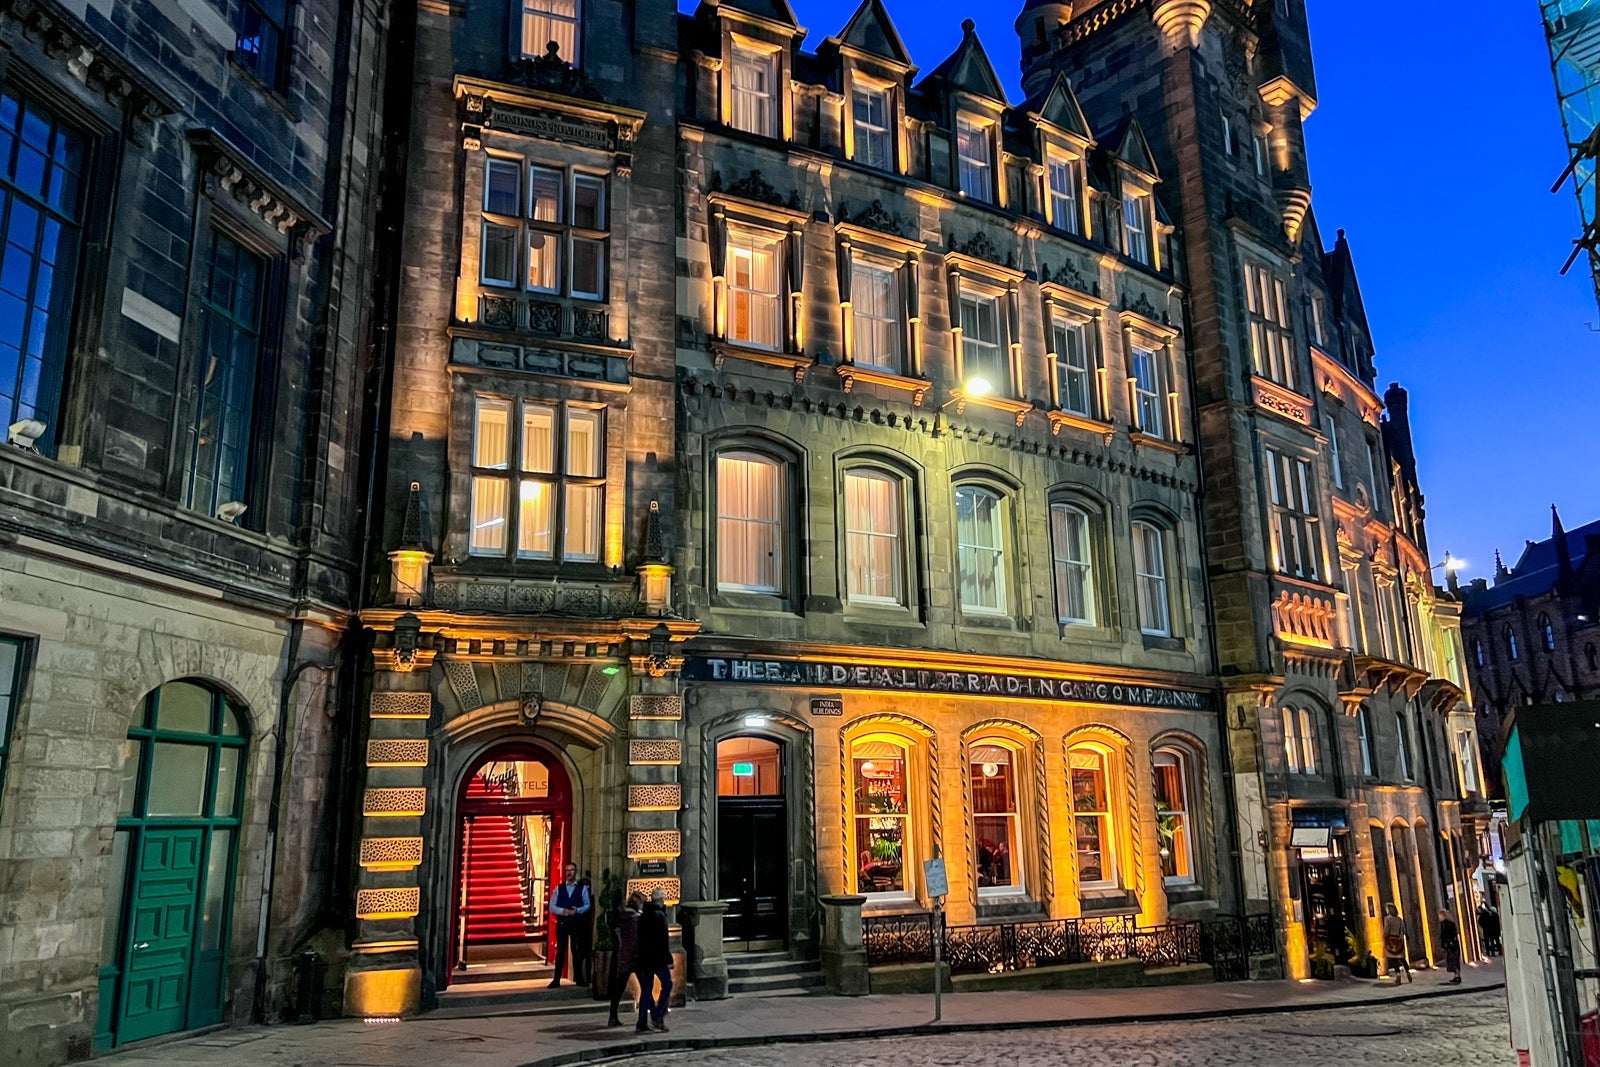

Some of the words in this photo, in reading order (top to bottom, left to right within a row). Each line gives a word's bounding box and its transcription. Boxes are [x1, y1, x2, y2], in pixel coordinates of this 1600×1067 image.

[707, 659, 782, 681] THE
[816, 664, 916, 687] IDEAL
[949, 672, 1073, 697] TRADING
[1096, 682, 1200, 708] COMPANY
[482, 761, 518, 792] Virgin
